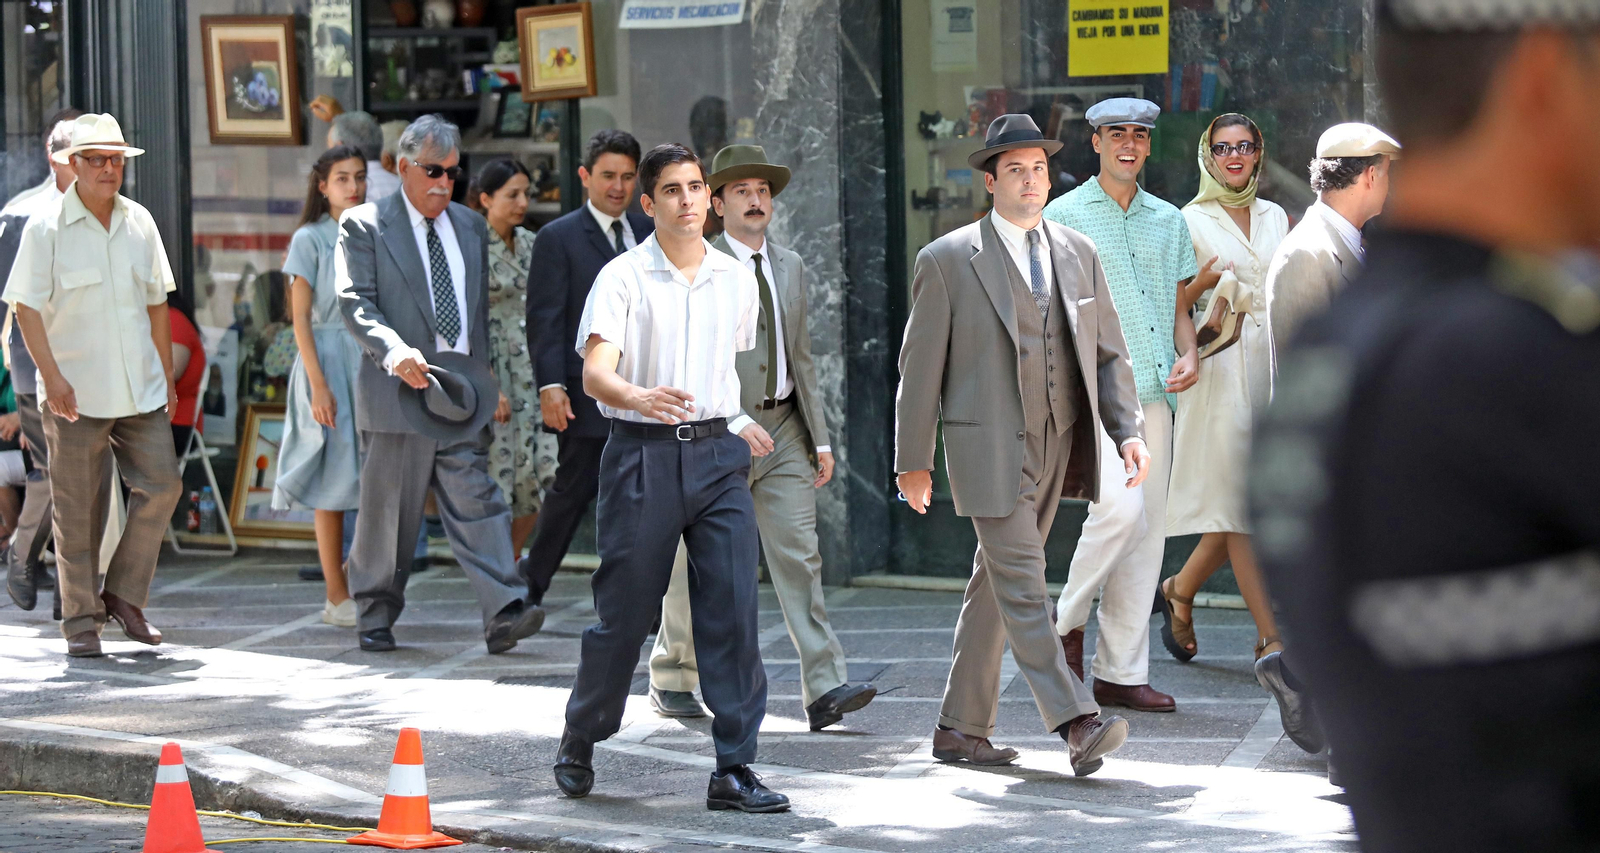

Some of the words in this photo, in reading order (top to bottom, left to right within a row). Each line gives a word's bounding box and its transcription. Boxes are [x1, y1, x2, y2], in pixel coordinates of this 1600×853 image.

[626, 6, 675, 20] SERVICIOS
[1072, 8, 1115, 21] CAMBIAMOS
[1119, 7, 1128, 19] SU
[1133, 6, 1164, 19] MAQUINA
[1077, 26, 1098, 38] VIEJA
[1102, 25, 1116, 37] POR
[1121, 24, 1135, 36] UNA
[1139, 23, 1160, 36] NUEVA
